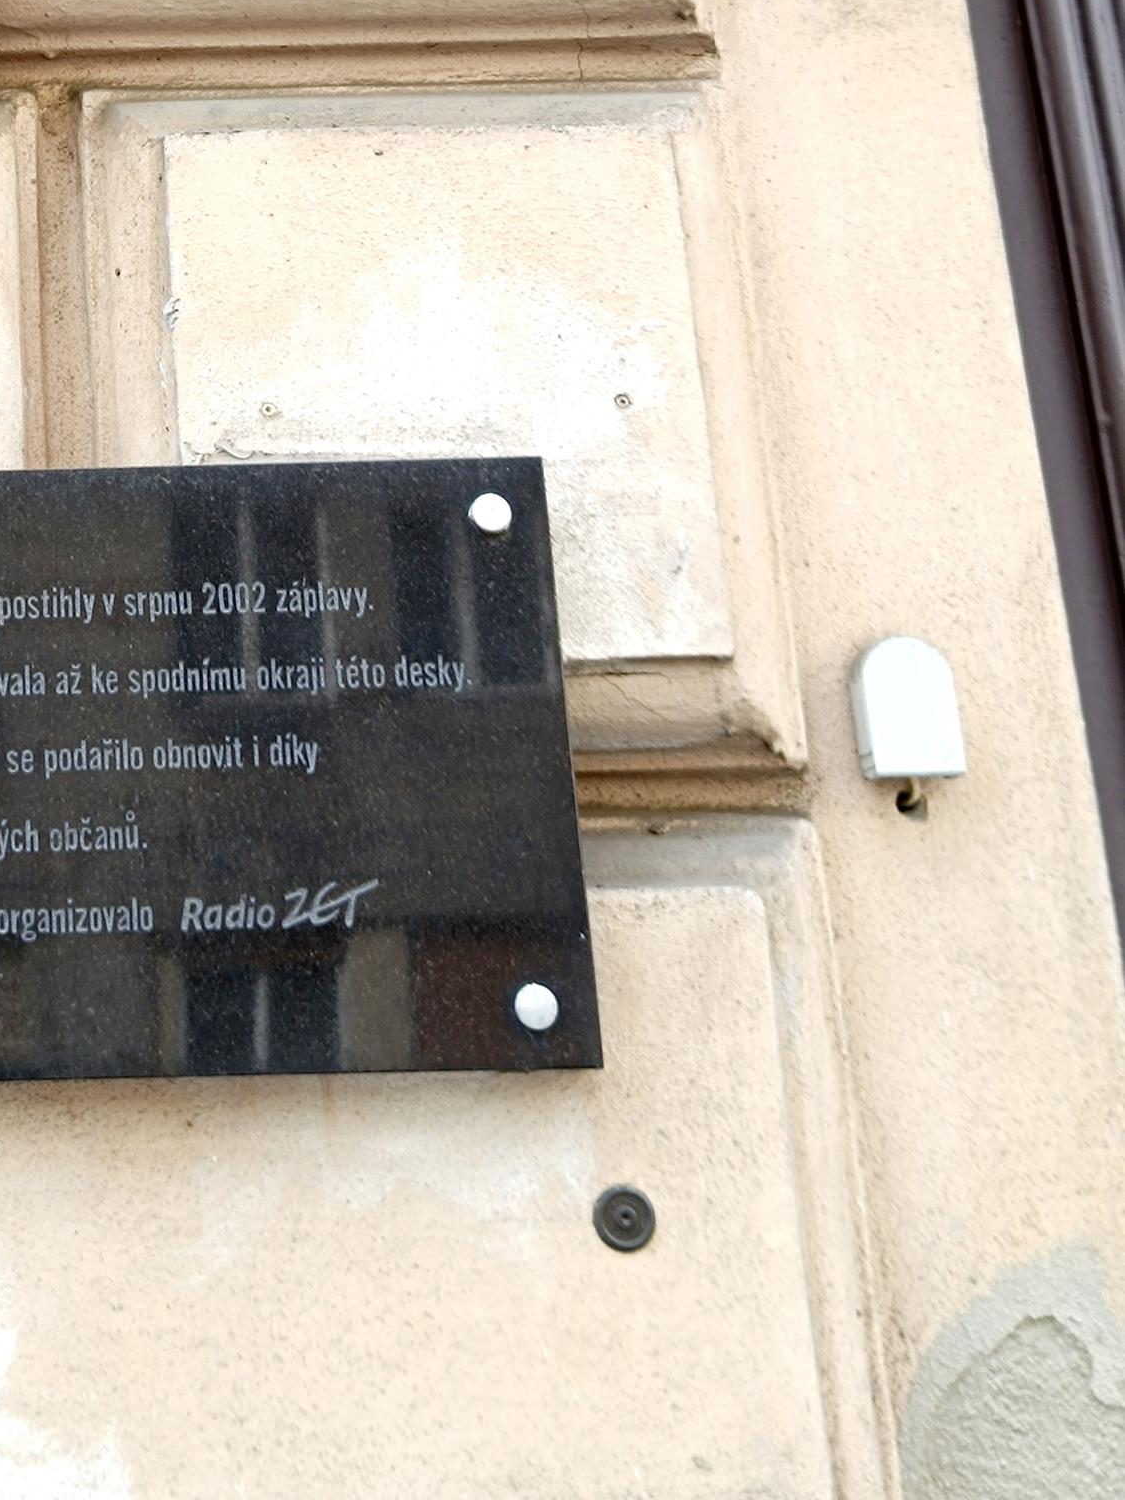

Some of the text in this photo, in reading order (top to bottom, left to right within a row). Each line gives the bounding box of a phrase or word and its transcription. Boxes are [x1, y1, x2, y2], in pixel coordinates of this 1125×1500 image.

[102, 592, 115, 615] v
[124, 589, 193, 621] srpnu
[201, 581, 266, 615] 2002
[275, 580, 374, 618] záplavy.
[55, 663, 82, 695] až
[91, 663, 119, 694] ke
[127, 657, 246, 698] spodnímu
[256, 657, 325, 695] okraji
[335, 655, 386, 689] této
[394, 654, 472, 693] desky.
[6, 749, 34, 774] se
[43, 738, 144, 779] podařilo
[153, 736, 243, 770] obnovit
[252, 735, 261, 768] i
[269, 732, 318, 775] díky
[50, 810, 148, 852] občanů.
[180, 896, 275, 932] Radio
[282, 878, 379, 930] ZET
